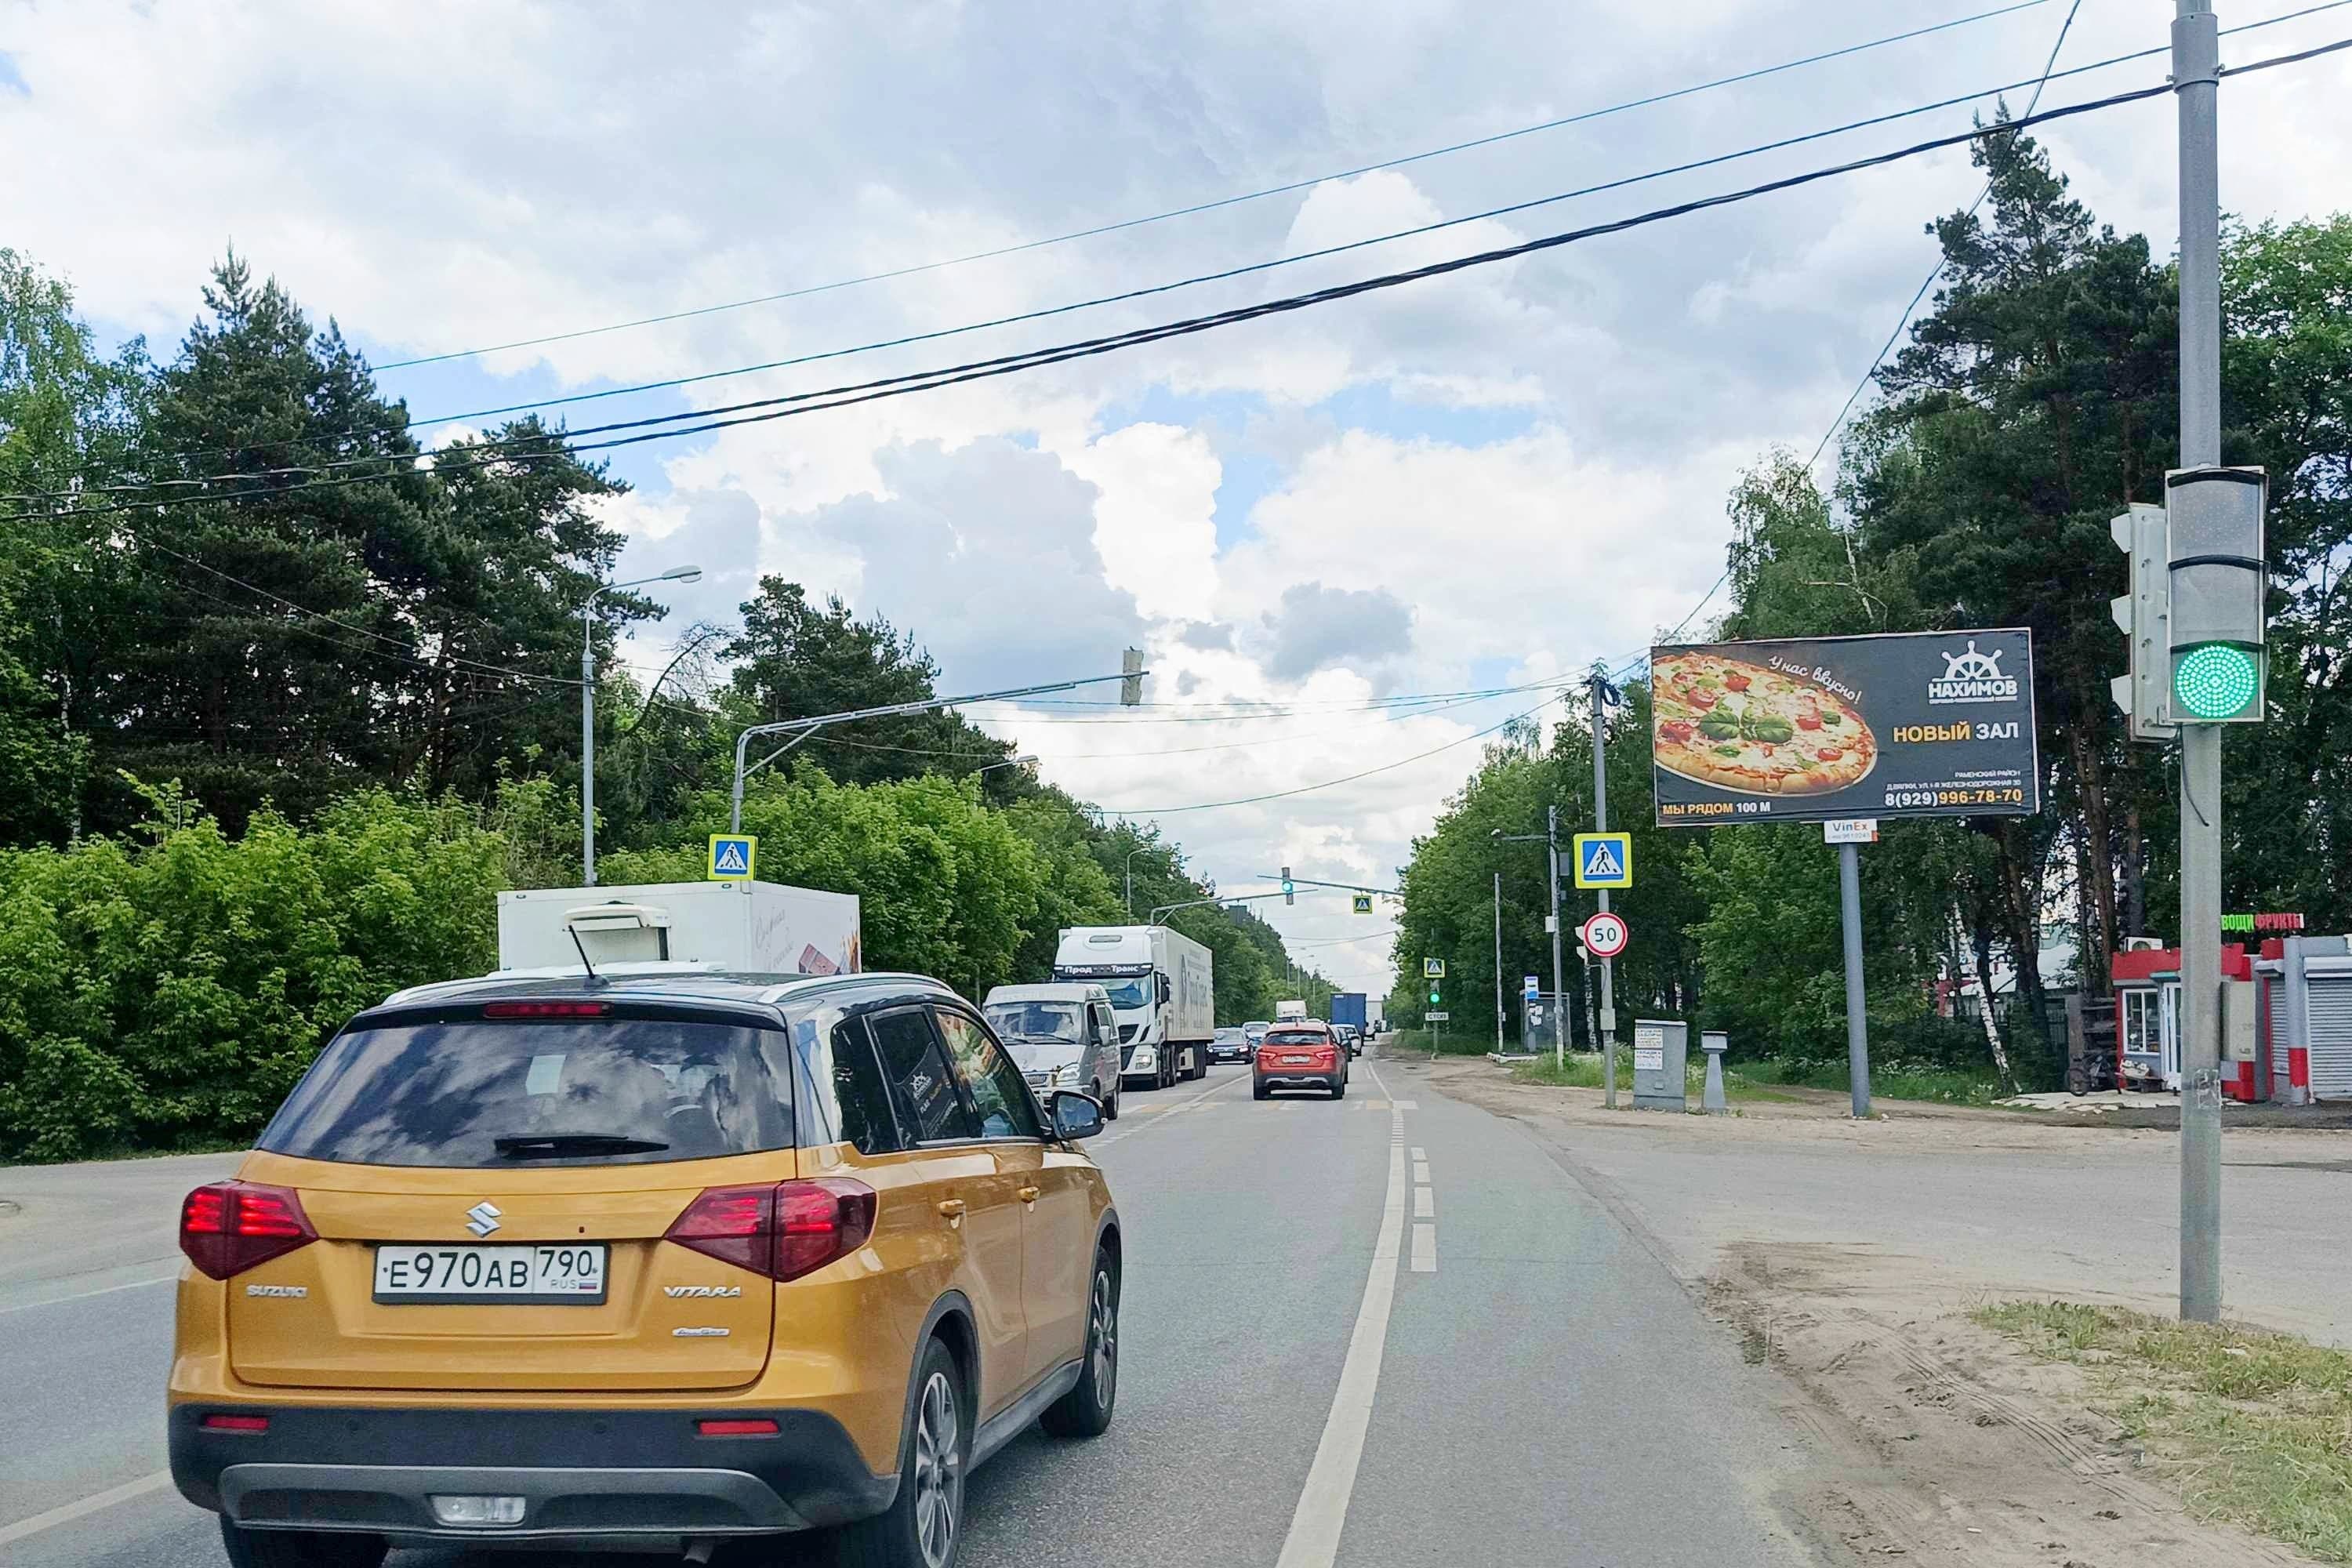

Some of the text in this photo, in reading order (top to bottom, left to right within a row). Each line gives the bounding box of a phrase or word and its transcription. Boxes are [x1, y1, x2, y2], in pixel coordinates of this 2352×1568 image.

[1769, 655, 1862, 704] У нас вкусно!
[1928, 680, 2018, 698] НАХИМОВ
[1893, 720, 2019, 742] НОВЫЙ ЗАЛ
[1885, 789, 2023, 808] 8(929)996-78-70
[1663, 801, 1771, 815] МЫ РЯДОМ 100 М
[1832, 822, 1867, 831] VinEx
[2220, 913, 2304, 933] ВОЩИ ФРУКТЫ
[1594, 927, 1617, 942] 50
[1065, 965, 1093, 975] Прод
[390, 1252, 528, 1288] Е970АВ
[539, 1250, 593, 1277] 790
[246, 1285, 308, 1298] SUZUKI
[550, 1279, 576, 1290] RUS
[663, 1286, 741, 1298] VITARA
